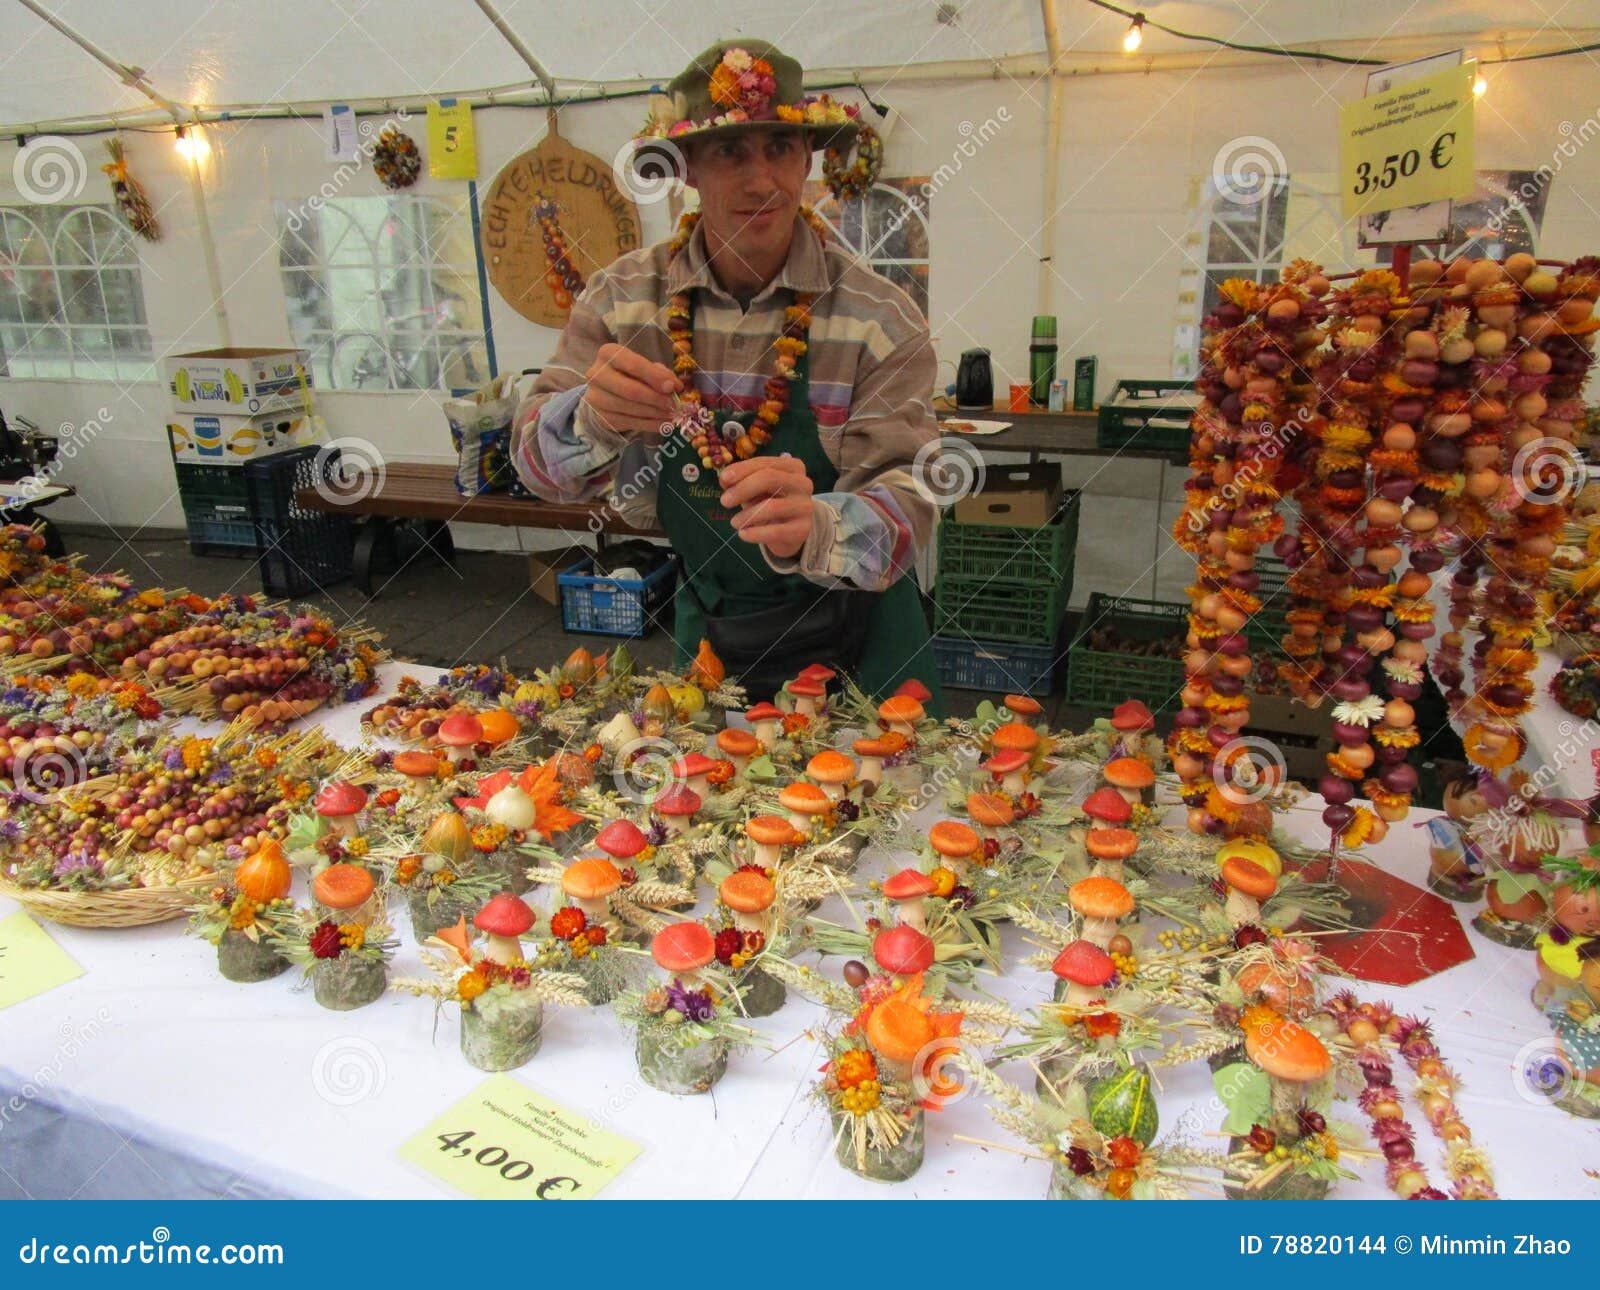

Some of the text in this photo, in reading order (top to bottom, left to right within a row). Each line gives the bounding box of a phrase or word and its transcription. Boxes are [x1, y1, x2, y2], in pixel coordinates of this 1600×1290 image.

[1353, 132, 1456, 195] 3,50 €
[437, 1131, 582, 1200] 4,00 €
